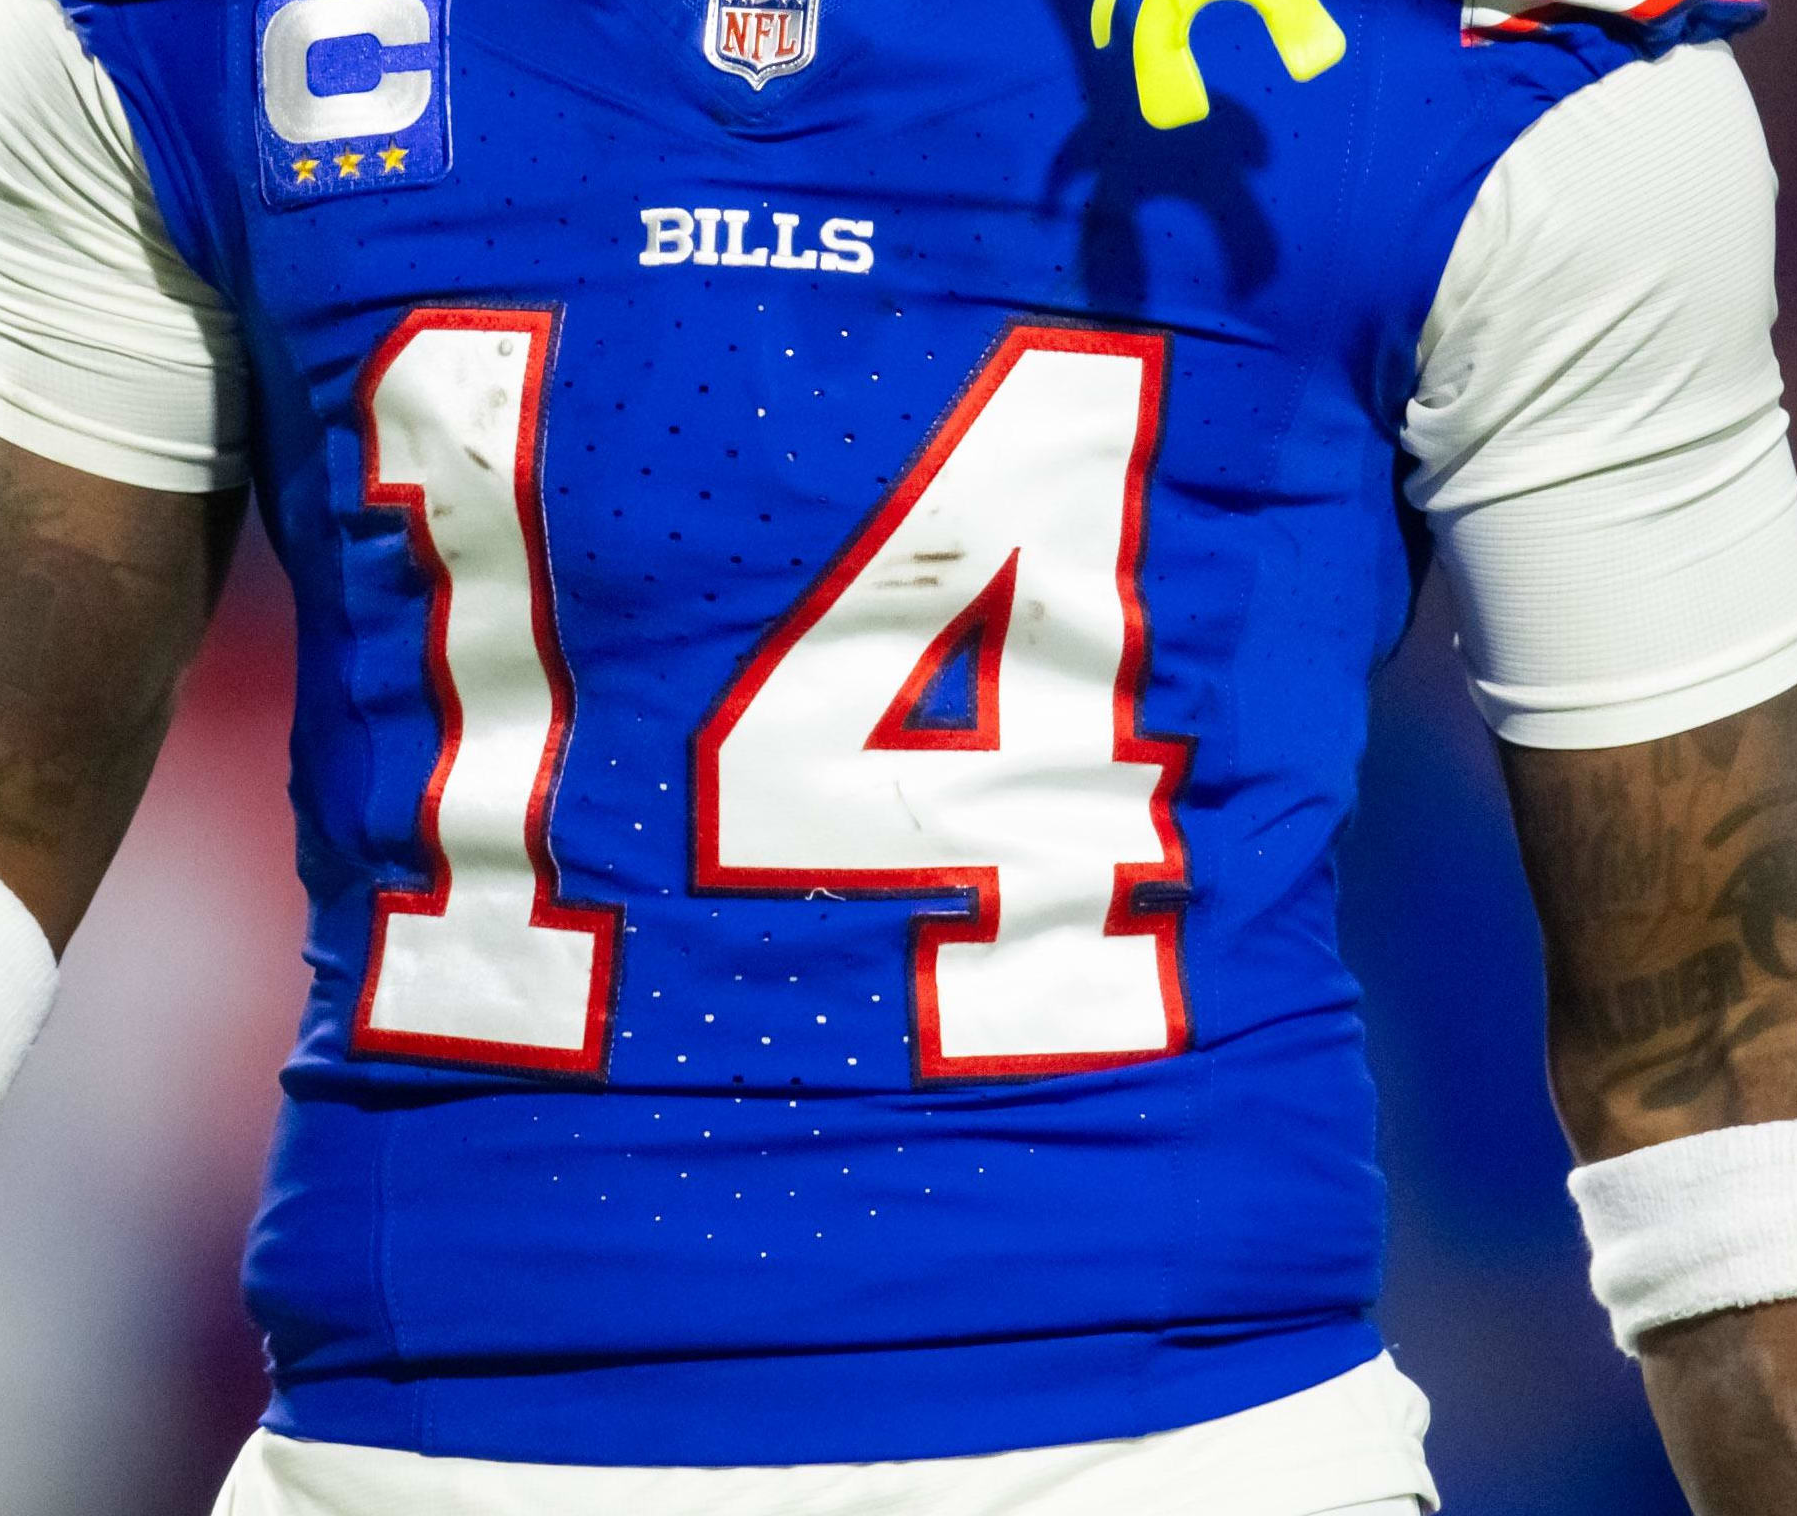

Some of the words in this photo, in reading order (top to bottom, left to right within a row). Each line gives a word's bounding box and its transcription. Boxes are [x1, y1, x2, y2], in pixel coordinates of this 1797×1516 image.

[722, 11, 797, 72] NFL
[639, 207, 875, 273] BILLS
[349, 301, 1197, 1087] 14
